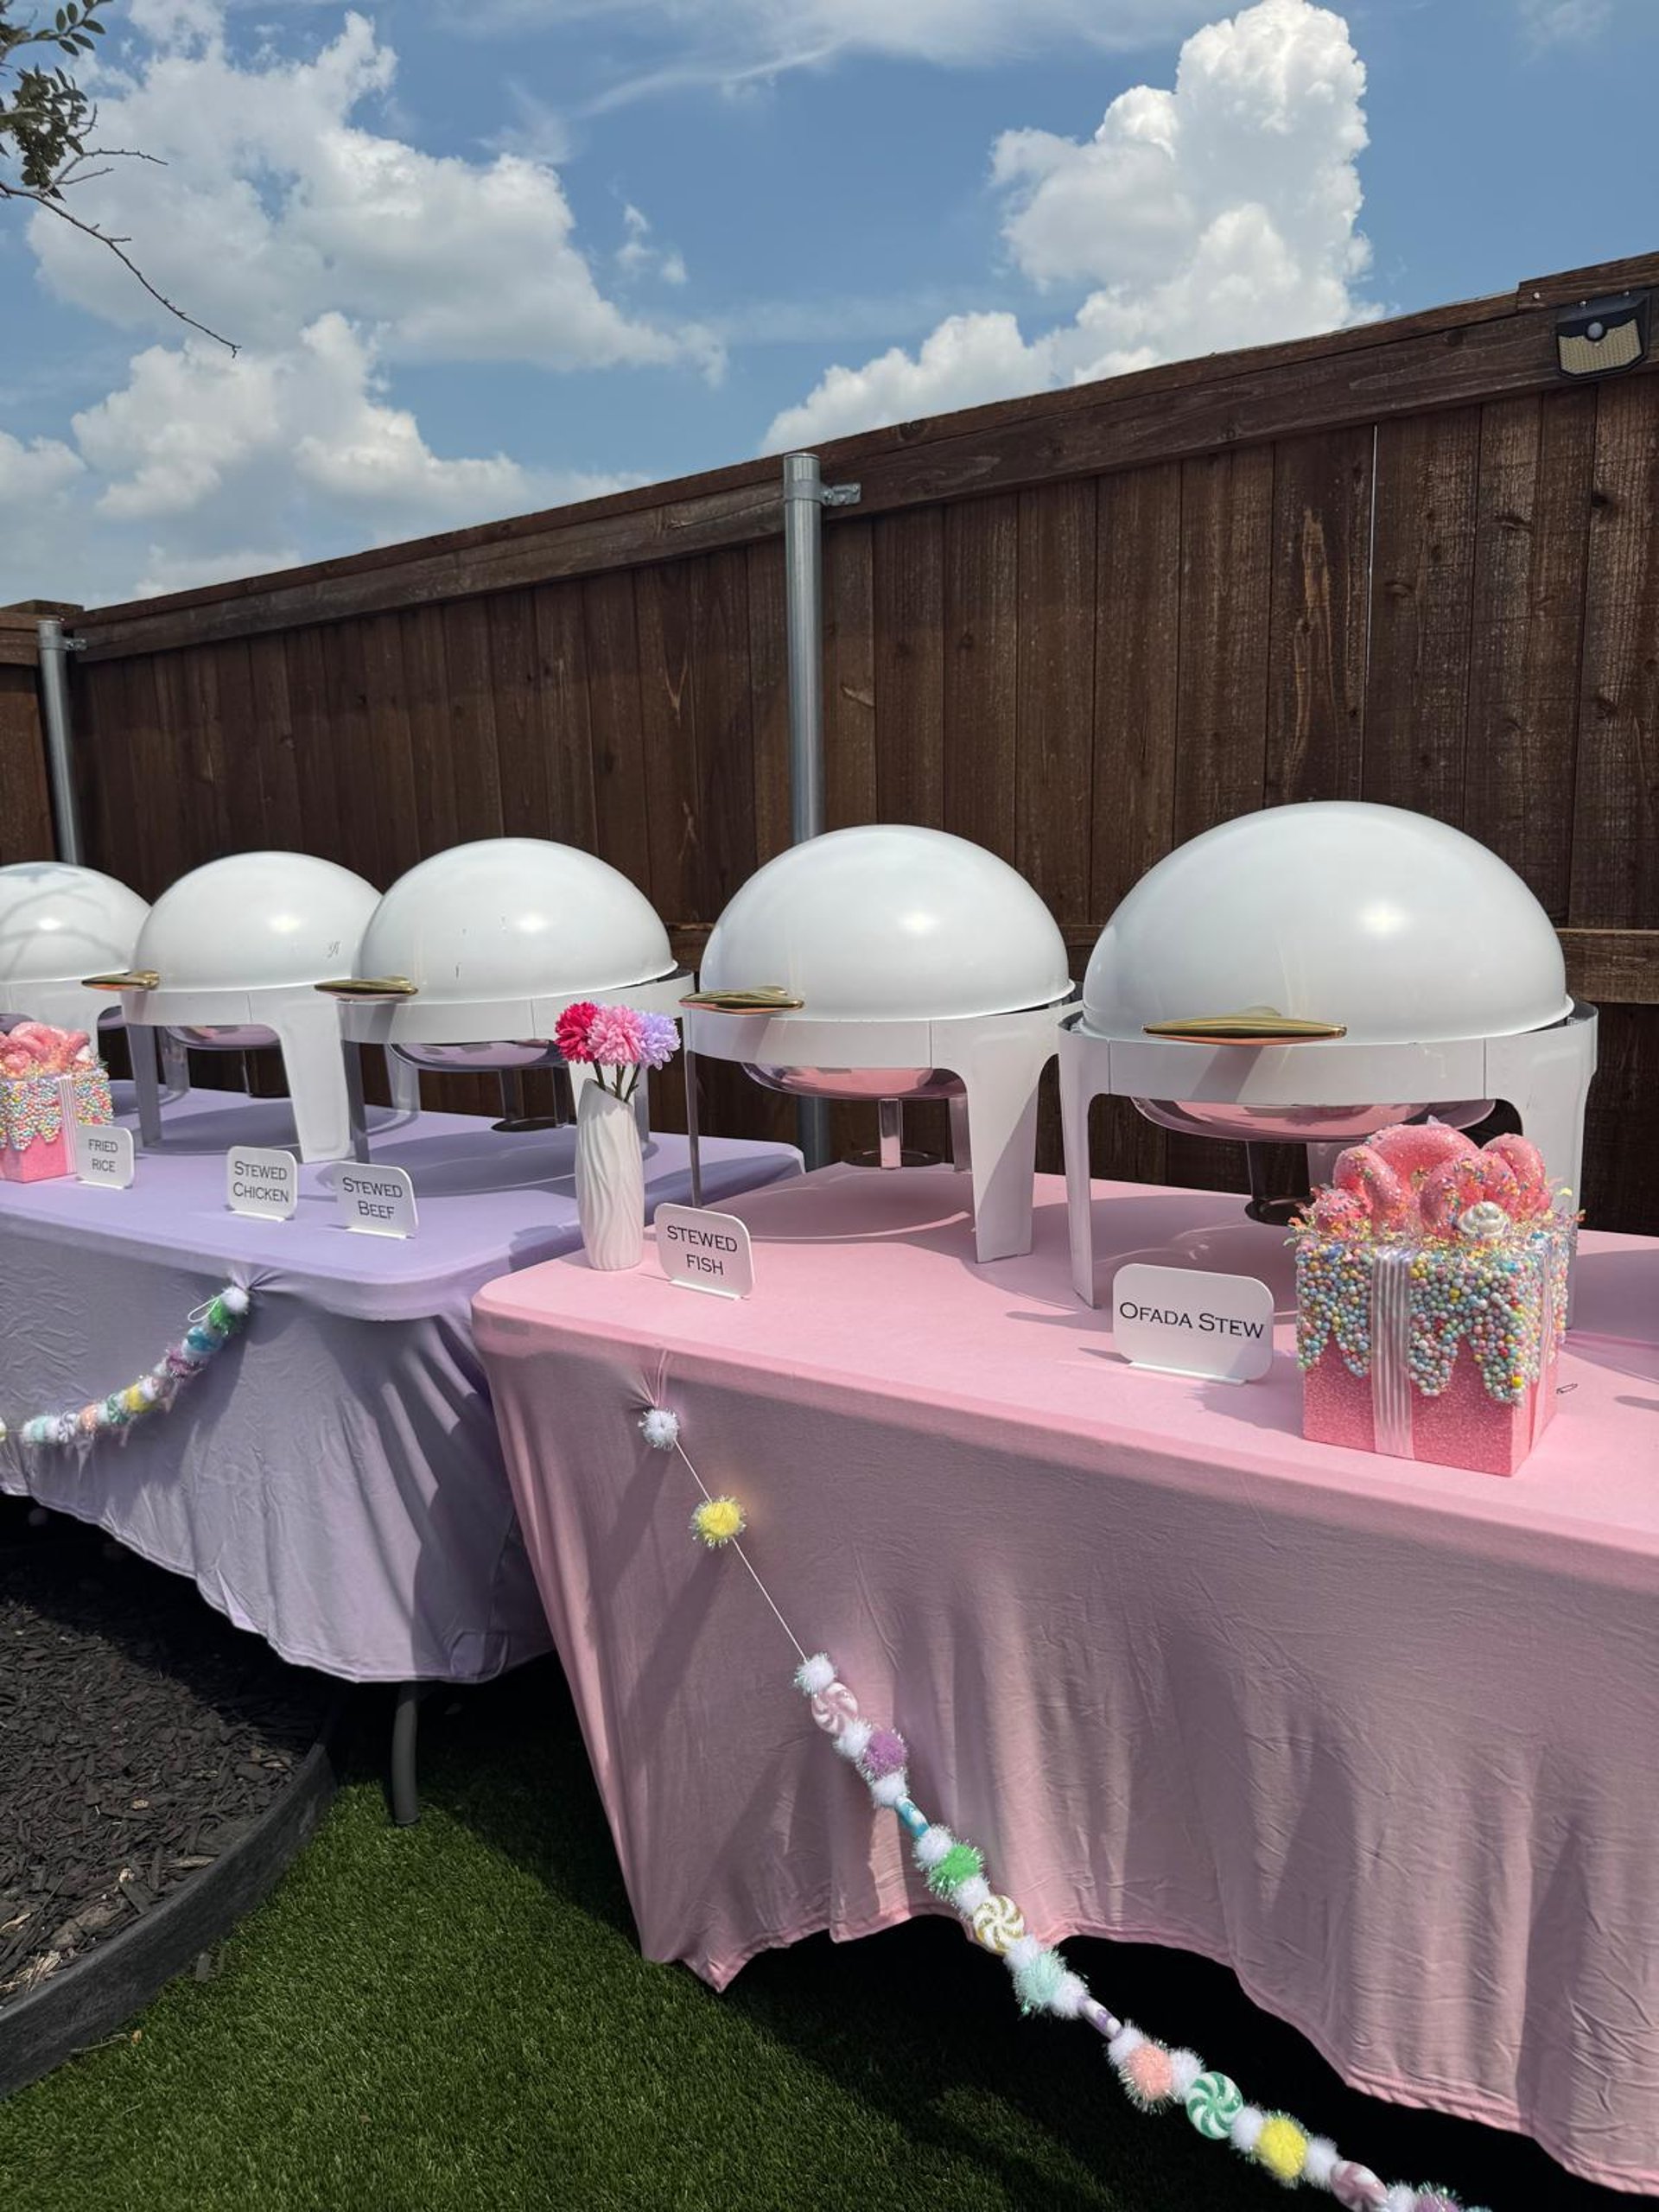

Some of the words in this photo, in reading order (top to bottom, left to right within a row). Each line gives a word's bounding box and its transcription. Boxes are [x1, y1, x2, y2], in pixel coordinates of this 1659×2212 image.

[88, 1139, 118, 1153] FRIED
[92, 1159, 116, 1173] RICE
[234, 1160, 288, 1180] STEWED
[232, 1181, 289, 1203] CHICKEN
[342, 1177, 403, 1198] STEWED
[358, 1200, 395, 1219] BEEF
[667, 1225, 738, 1252] STEWED
[686, 1254, 724, 1275] FISH
[1119, 1301, 1193, 1329] OFADA
[1198, 1313, 1264, 1338] STEW
